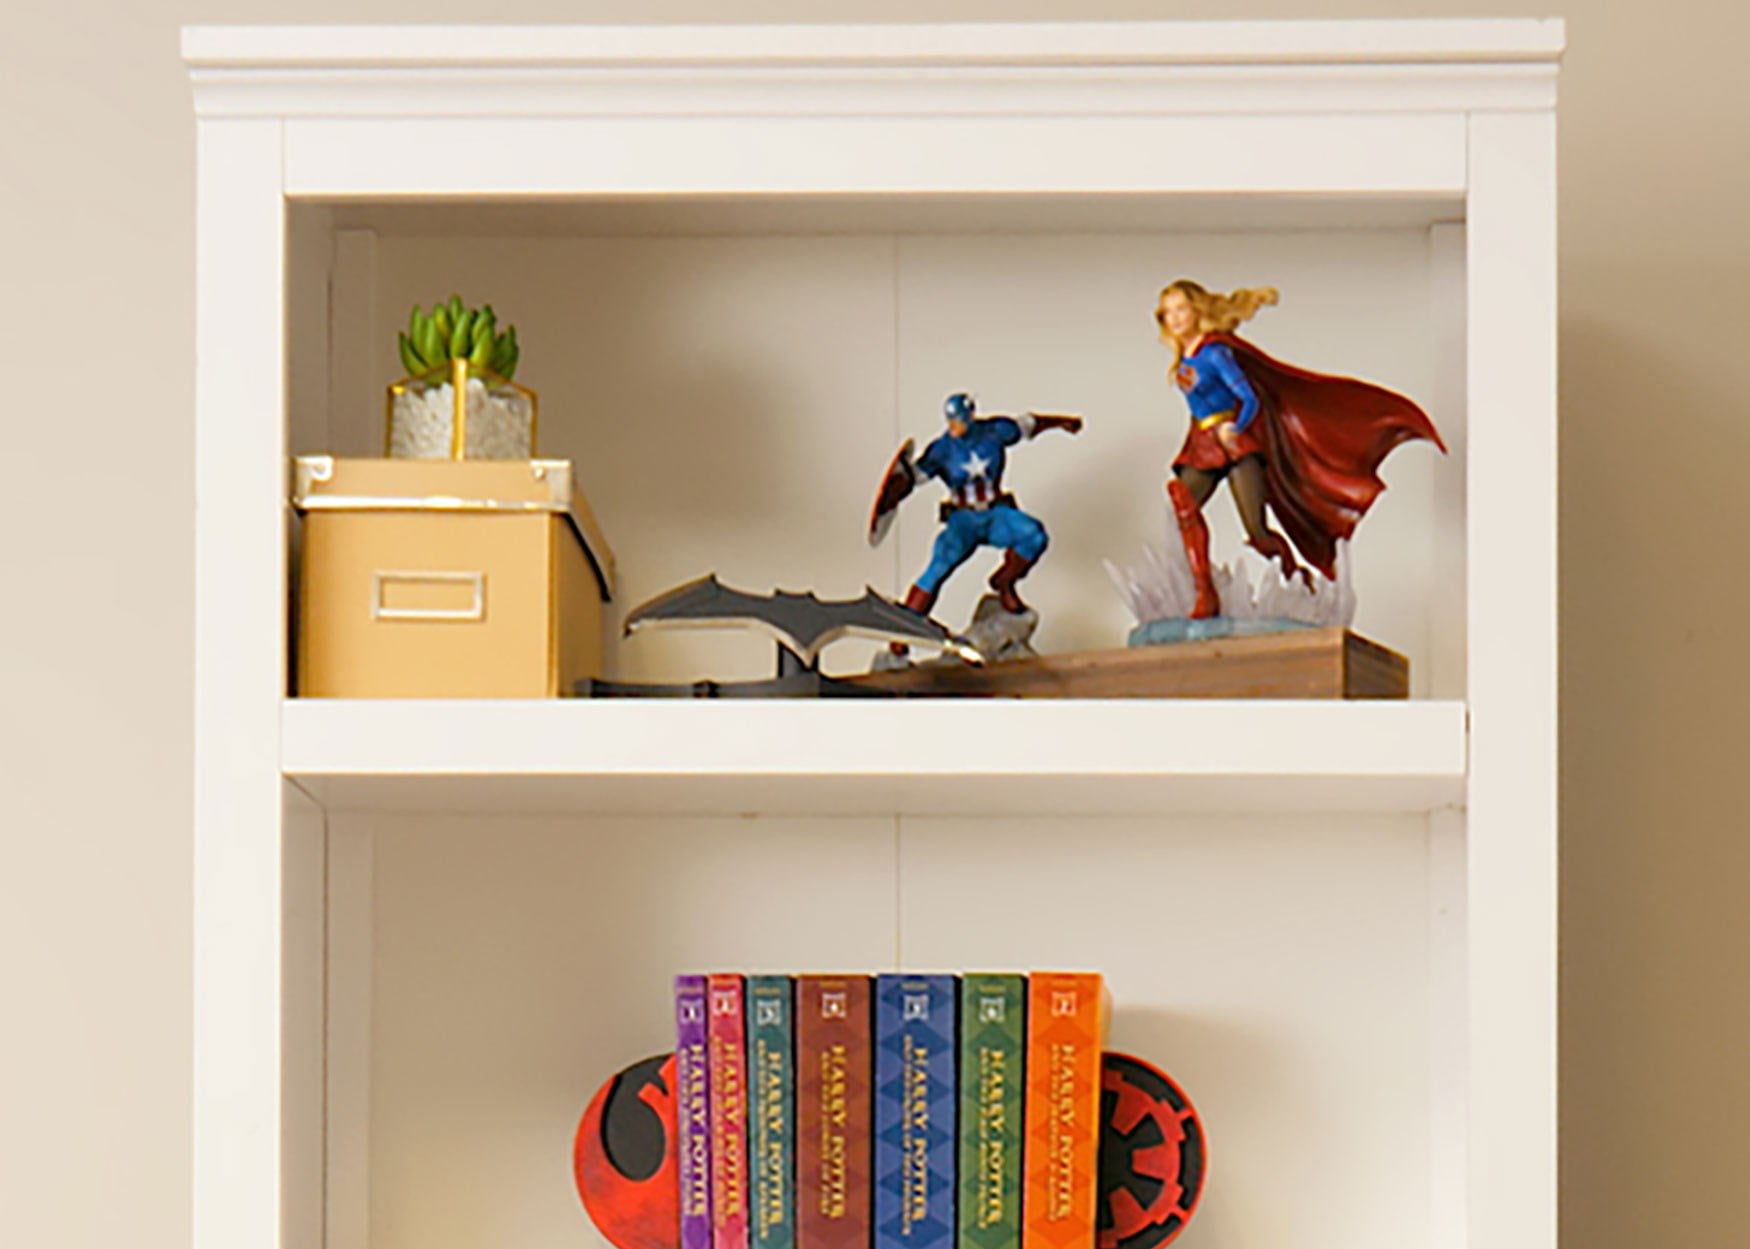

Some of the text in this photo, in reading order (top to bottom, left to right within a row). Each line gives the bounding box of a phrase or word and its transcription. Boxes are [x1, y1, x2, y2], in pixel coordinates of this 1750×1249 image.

[690, 1044, 706, 1216] HARRY POTTER
[724, 1043, 739, 1216] HARRY POTTER
[768, 1051, 784, 1224] HARRY POTTER
[829, 1045, 847, 1218] HARRY POTTER
[912, 1047, 928, 1221] HARRY POTTER
[986, 1050, 1005, 1223] HARRY POTTER
[1058, 1044, 1075, 1217] HARRY POTTER
